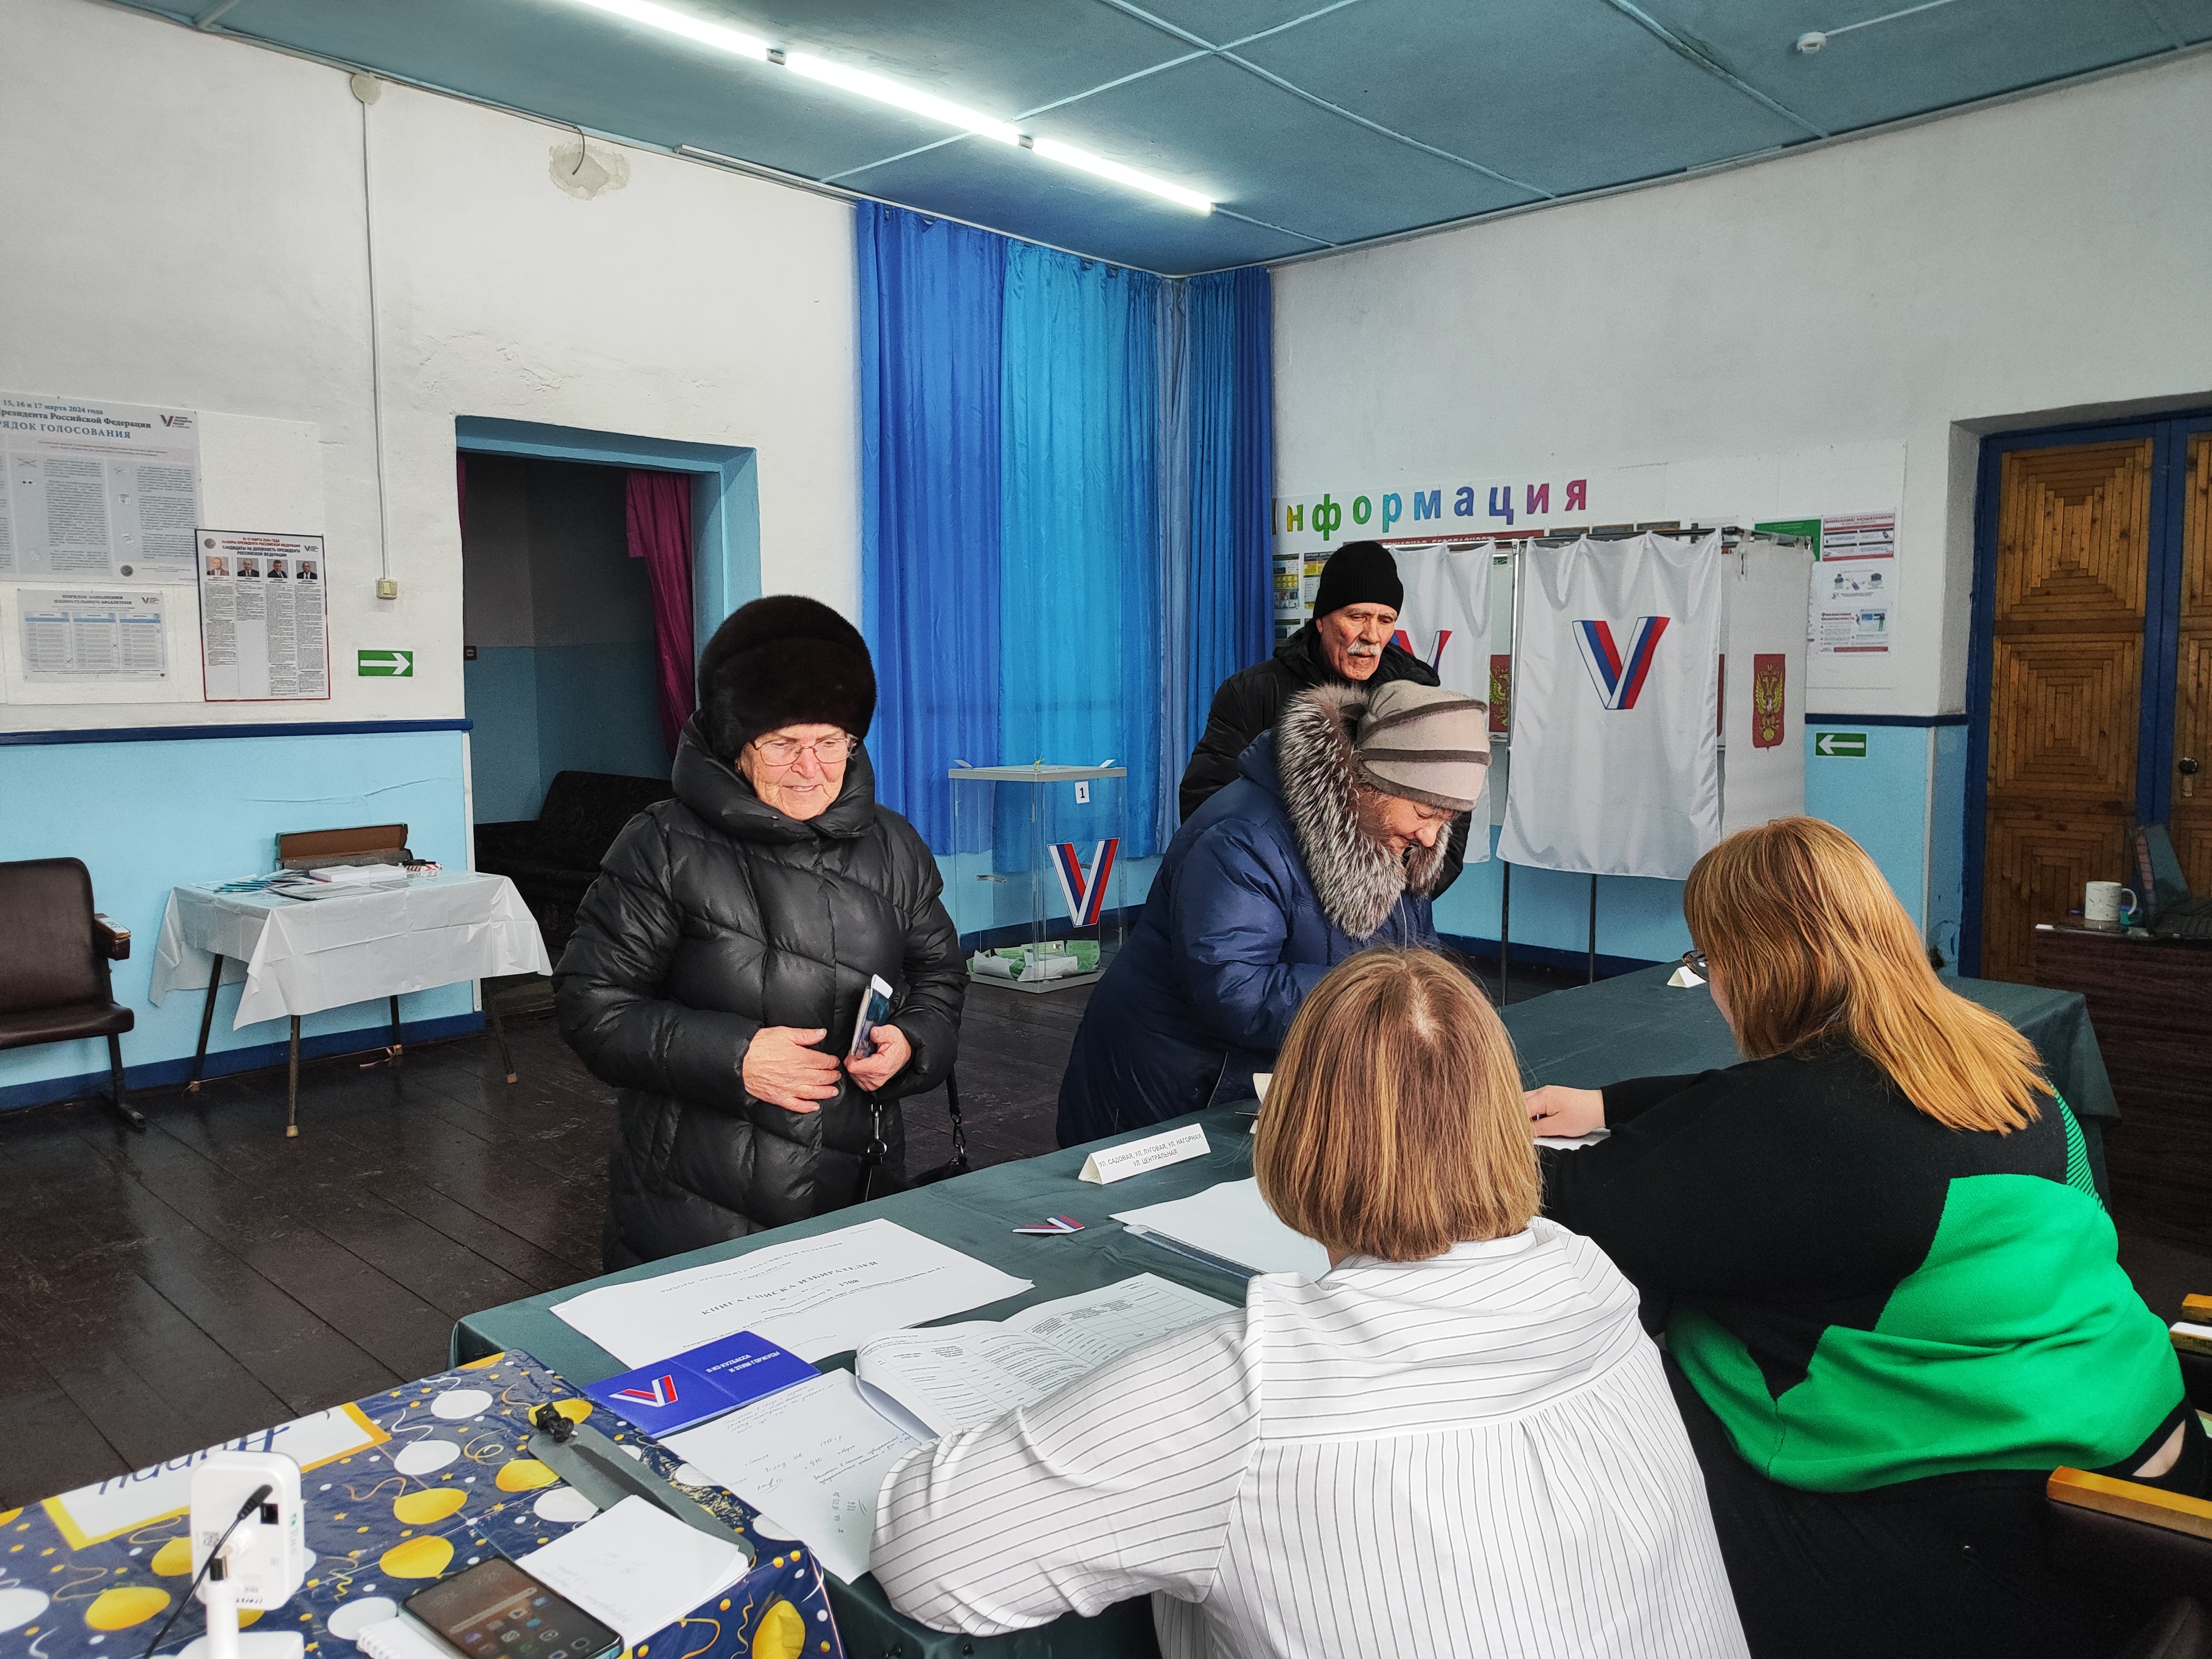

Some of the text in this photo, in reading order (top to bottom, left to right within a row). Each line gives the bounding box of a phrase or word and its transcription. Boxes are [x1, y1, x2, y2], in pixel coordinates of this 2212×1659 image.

[3, 399, 14, 408] 15,
[45, 404, 67, 413] марта
[50, 413, 102, 424] Российской
[103, 417, 152, 429] Федерации
[0, 420, 131, 439] ЯДОК ГОЛОСОВАНИЯ
[1079, 786, 1086, 799] 1
[1108, 1153, 1135, 1165] САДОВАЯ,
[1144, 1143, 1168, 1155] ЛУГОВАЯ,
[1142, 1149, 1178, 1165] ЦЕНТРАЛЬНАЯ
[701, 1297, 745, 1315] КНИГА
[747, 1284, 796, 1300] СПИСКА
[797, 1260, 879, 1285] ИЗБИРАТЕЛЕЙ
